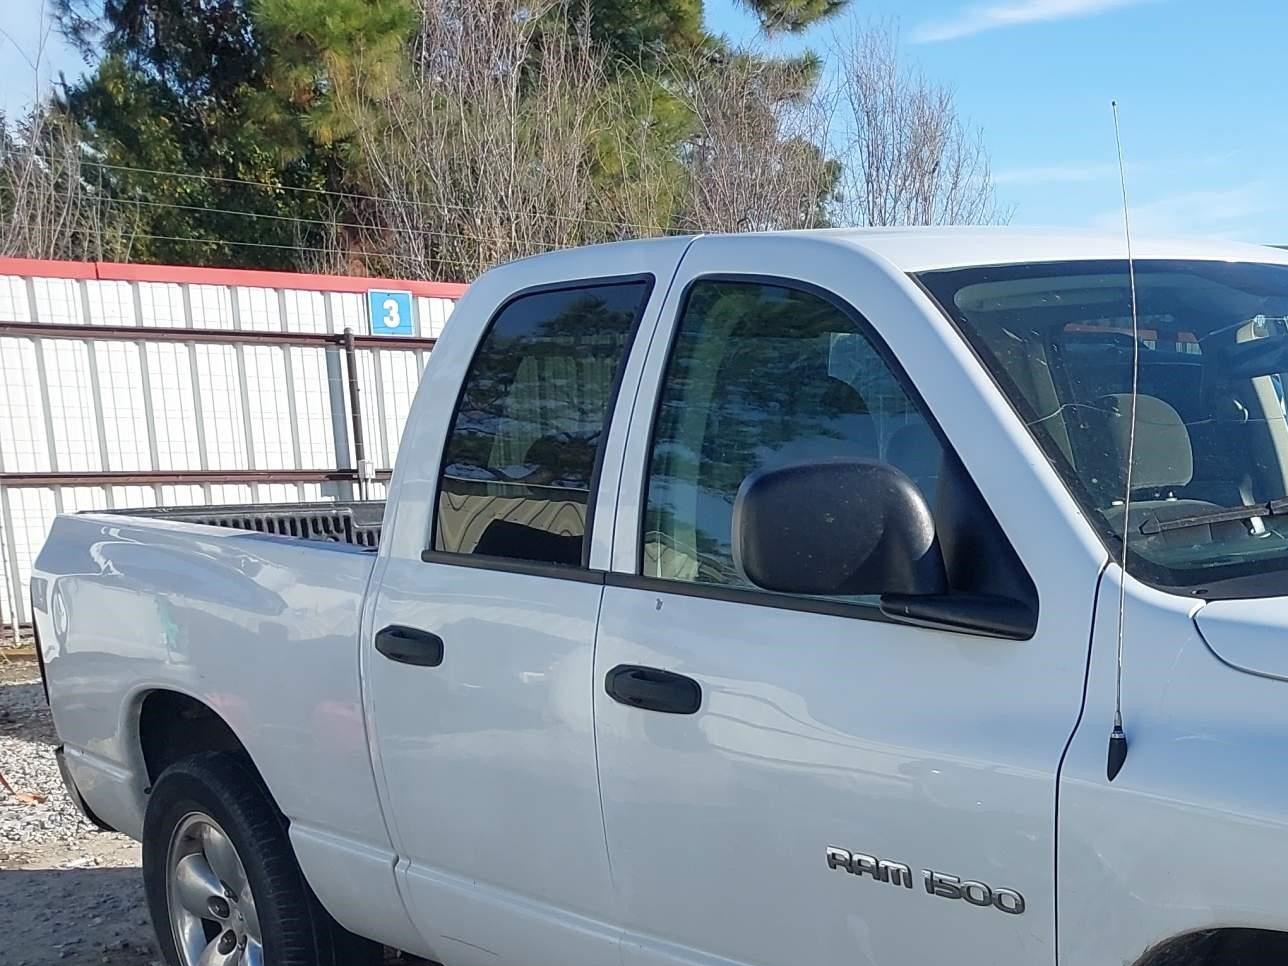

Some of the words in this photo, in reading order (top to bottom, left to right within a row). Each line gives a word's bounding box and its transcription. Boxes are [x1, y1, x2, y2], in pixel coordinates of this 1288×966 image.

[383, 299, 401, 328] 3
[825, 844, 913, 889] RAM
[921, 868, 1026, 915] 1500
